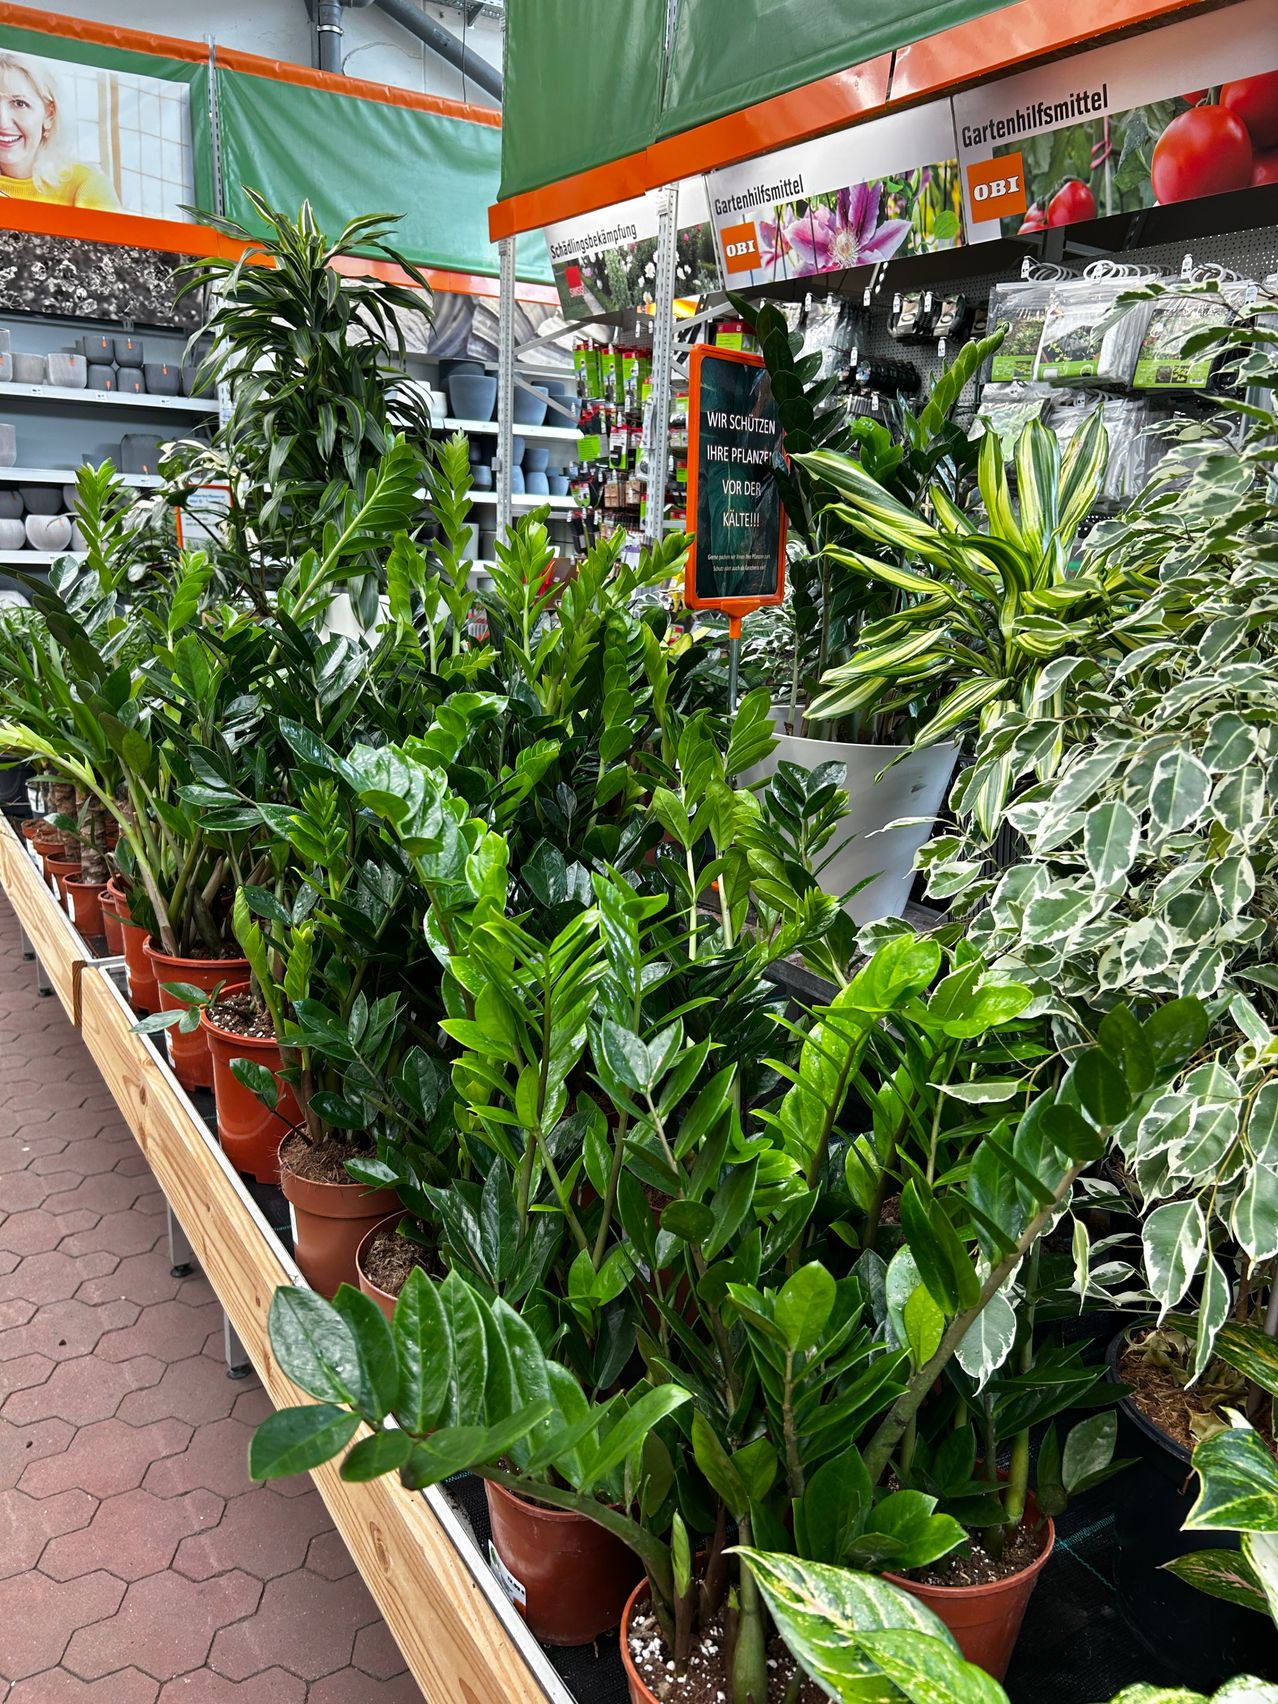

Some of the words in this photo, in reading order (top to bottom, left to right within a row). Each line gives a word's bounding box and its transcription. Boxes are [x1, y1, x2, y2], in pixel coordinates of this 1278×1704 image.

[961, 83, 1108, 148] Gartenhilfsmittel
[714, 173, 804, 216] Gartenhilfsmittel
[973, 175, 1020, 202] OBI
[549, 223, 638, 259] Schädlingsbekämpfung
[726, 239, 756, 257] OBI
[706, 411, 728, 429] WIR
[729, 413, 776, 435] SCHÜTZEN
[707, 444, 730, 462] IHRE
[731, 447, 772, 465] PFLANZE
[722, 479, 742, 495] VOR
[744, 480, 761, 496] DER
[722, 508, 760, 528] KÄLTE!!!
